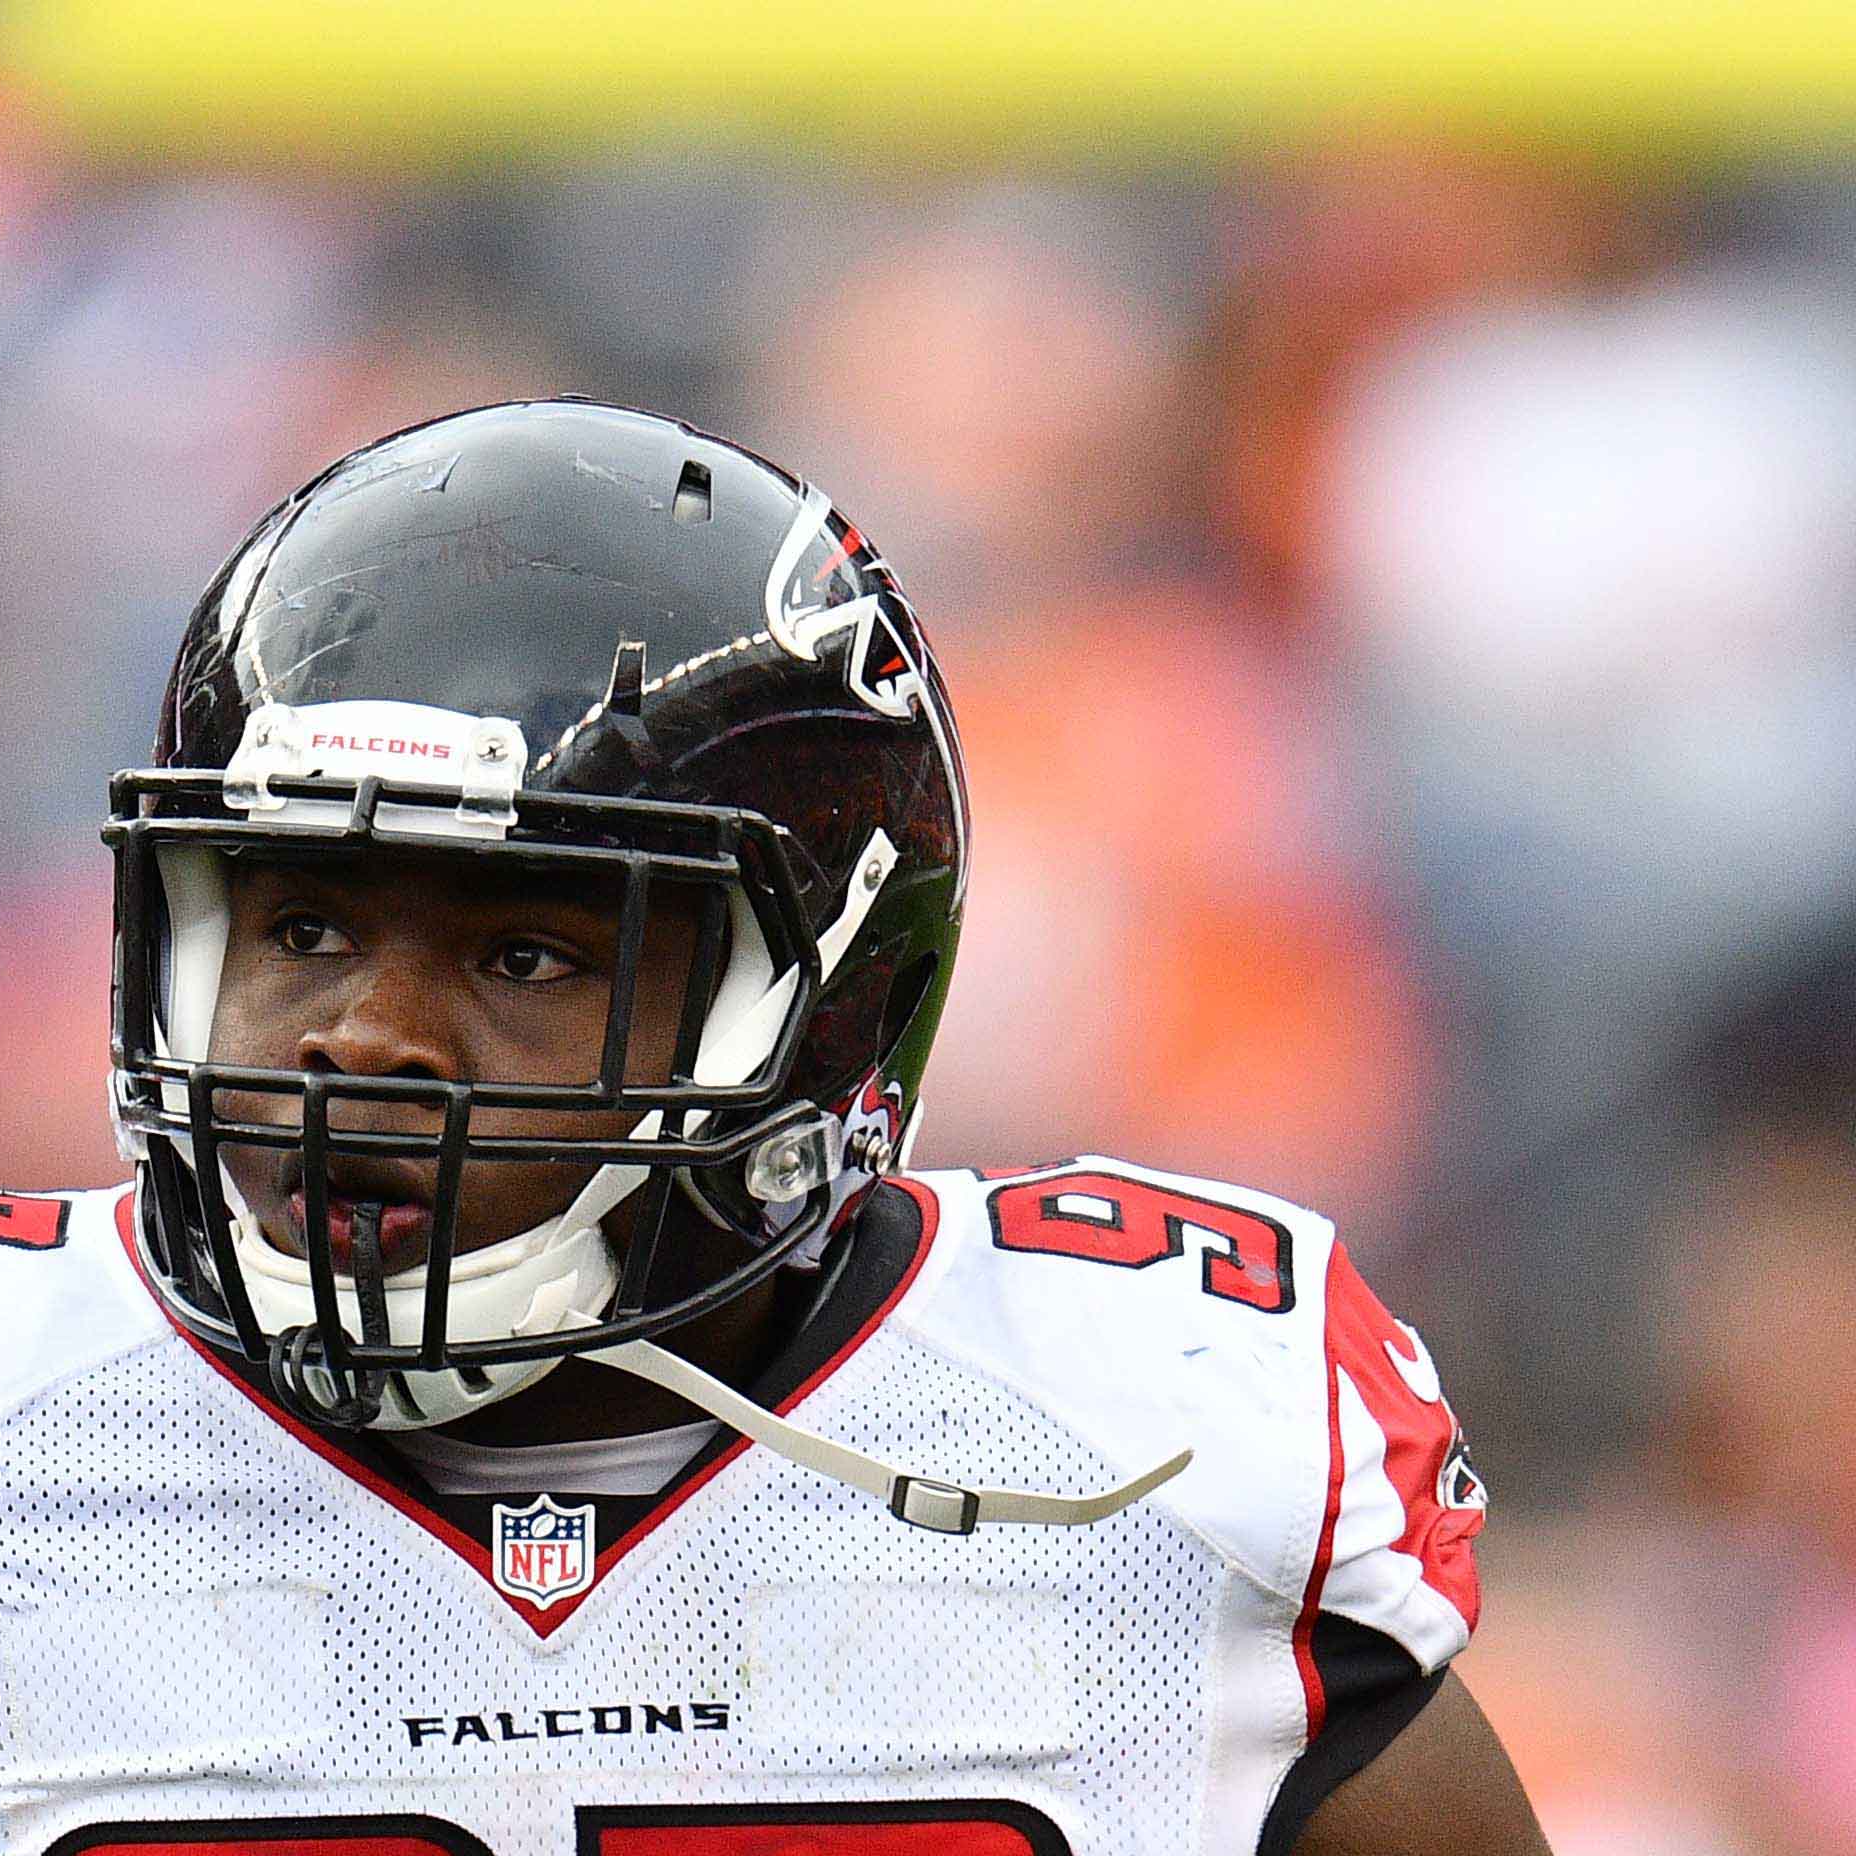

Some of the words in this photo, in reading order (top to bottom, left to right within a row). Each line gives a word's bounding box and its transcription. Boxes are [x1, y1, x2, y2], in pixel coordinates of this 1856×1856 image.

[312, 734, 451, 759] FALCONS
[510, 1543, 578, 1587] NFL
[400, 1702, 731, 1747] FALCONS
